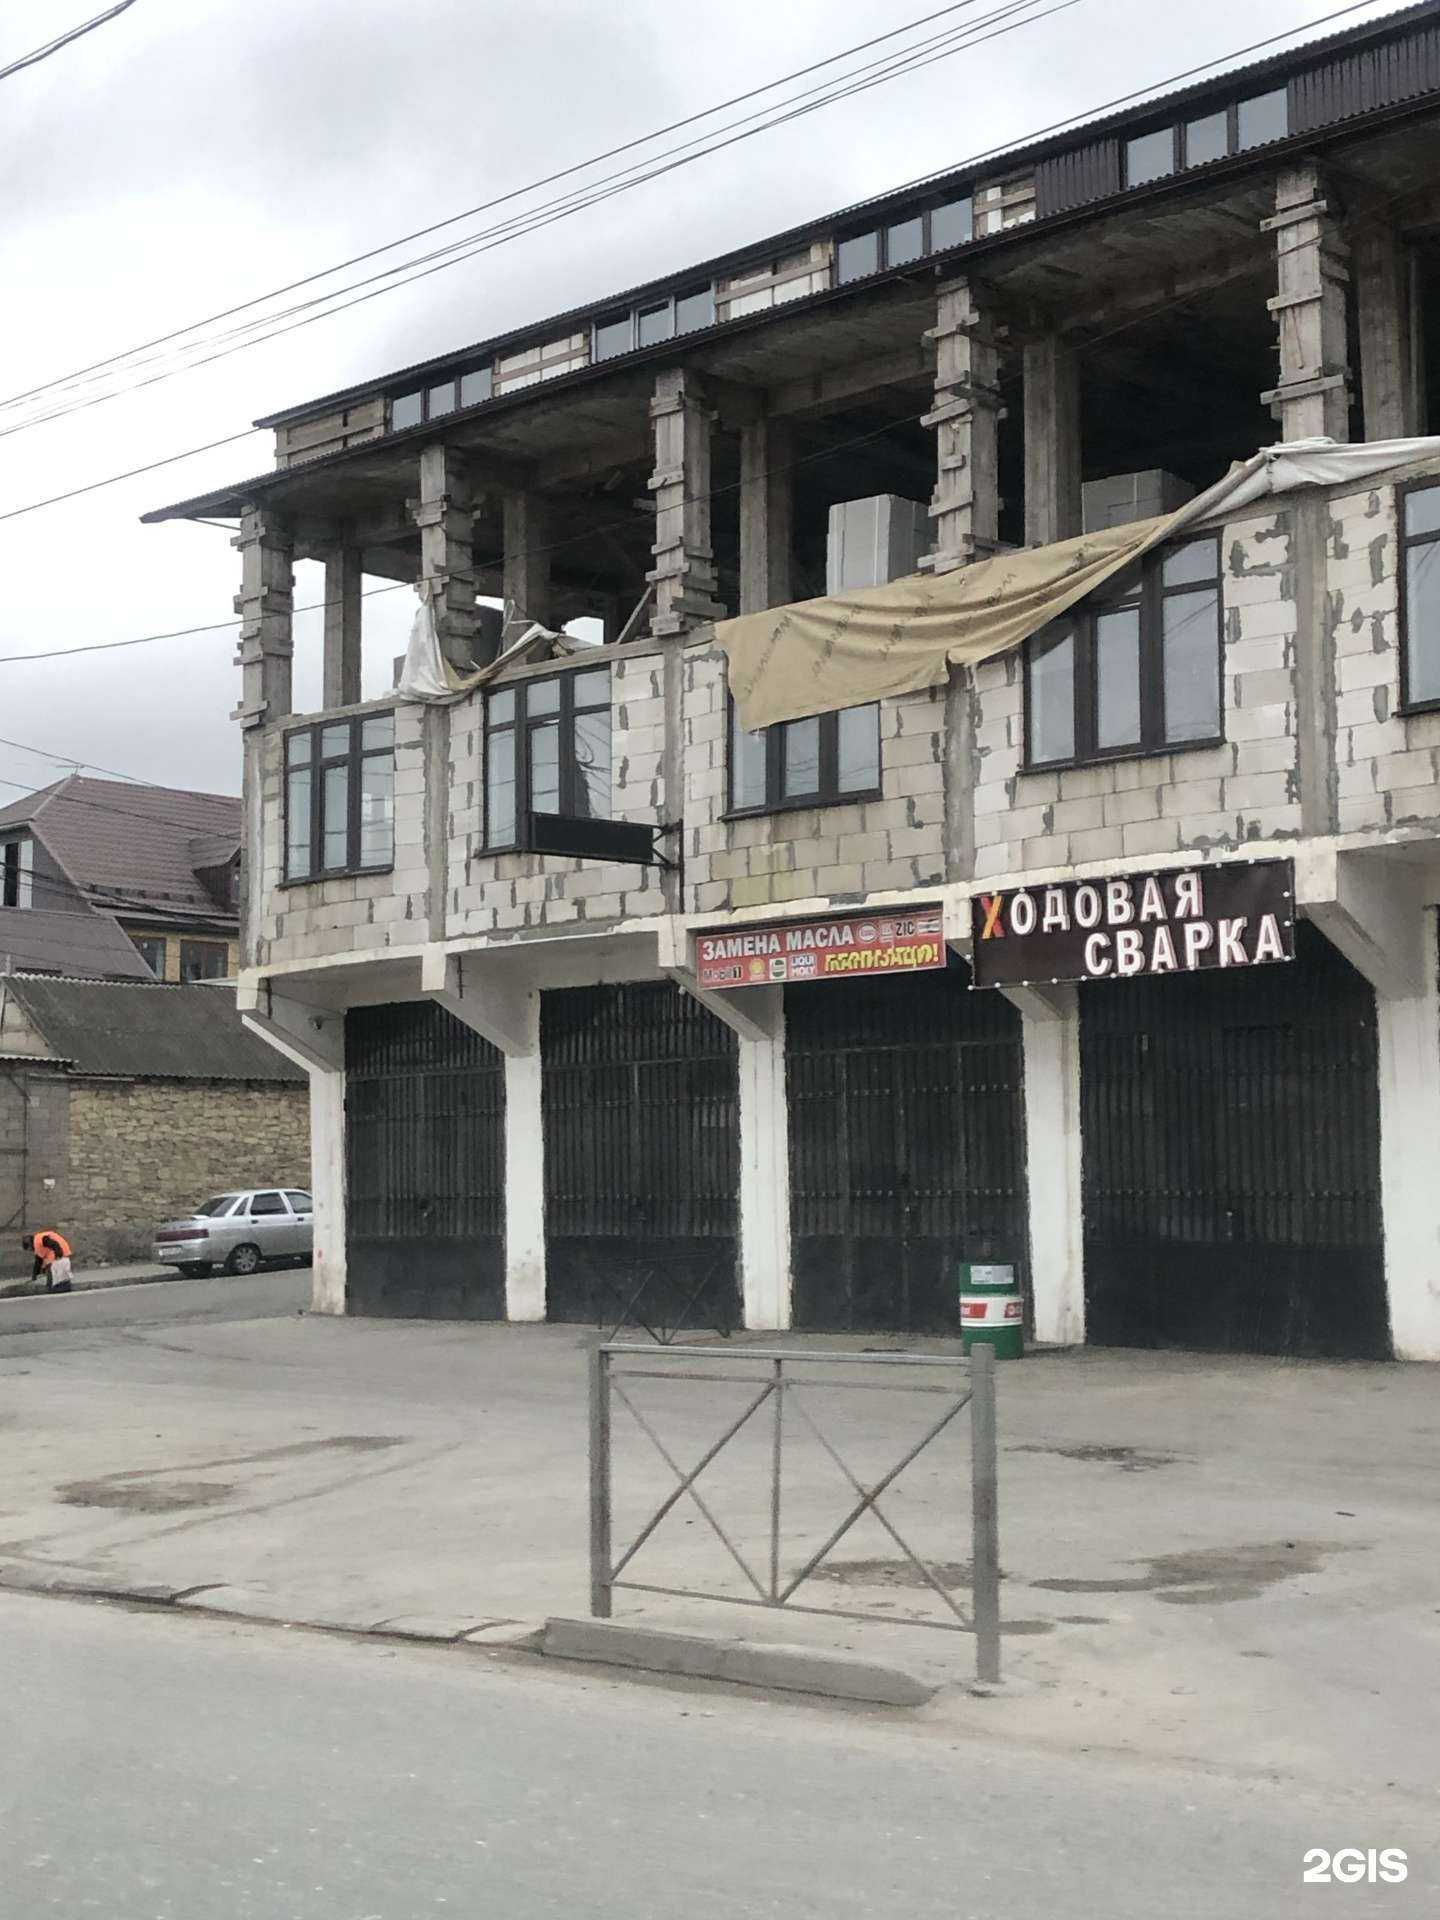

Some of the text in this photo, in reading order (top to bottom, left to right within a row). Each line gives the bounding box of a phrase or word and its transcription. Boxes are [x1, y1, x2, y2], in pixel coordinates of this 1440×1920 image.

[979, 872, 1204, 940] ХОДОВАЯ
[703, 934, 781, 961] ЗАМЕНА
[786, 925, 854, 951] МАСЛА
[1084, 912, 1285, 977] СВАРКА
